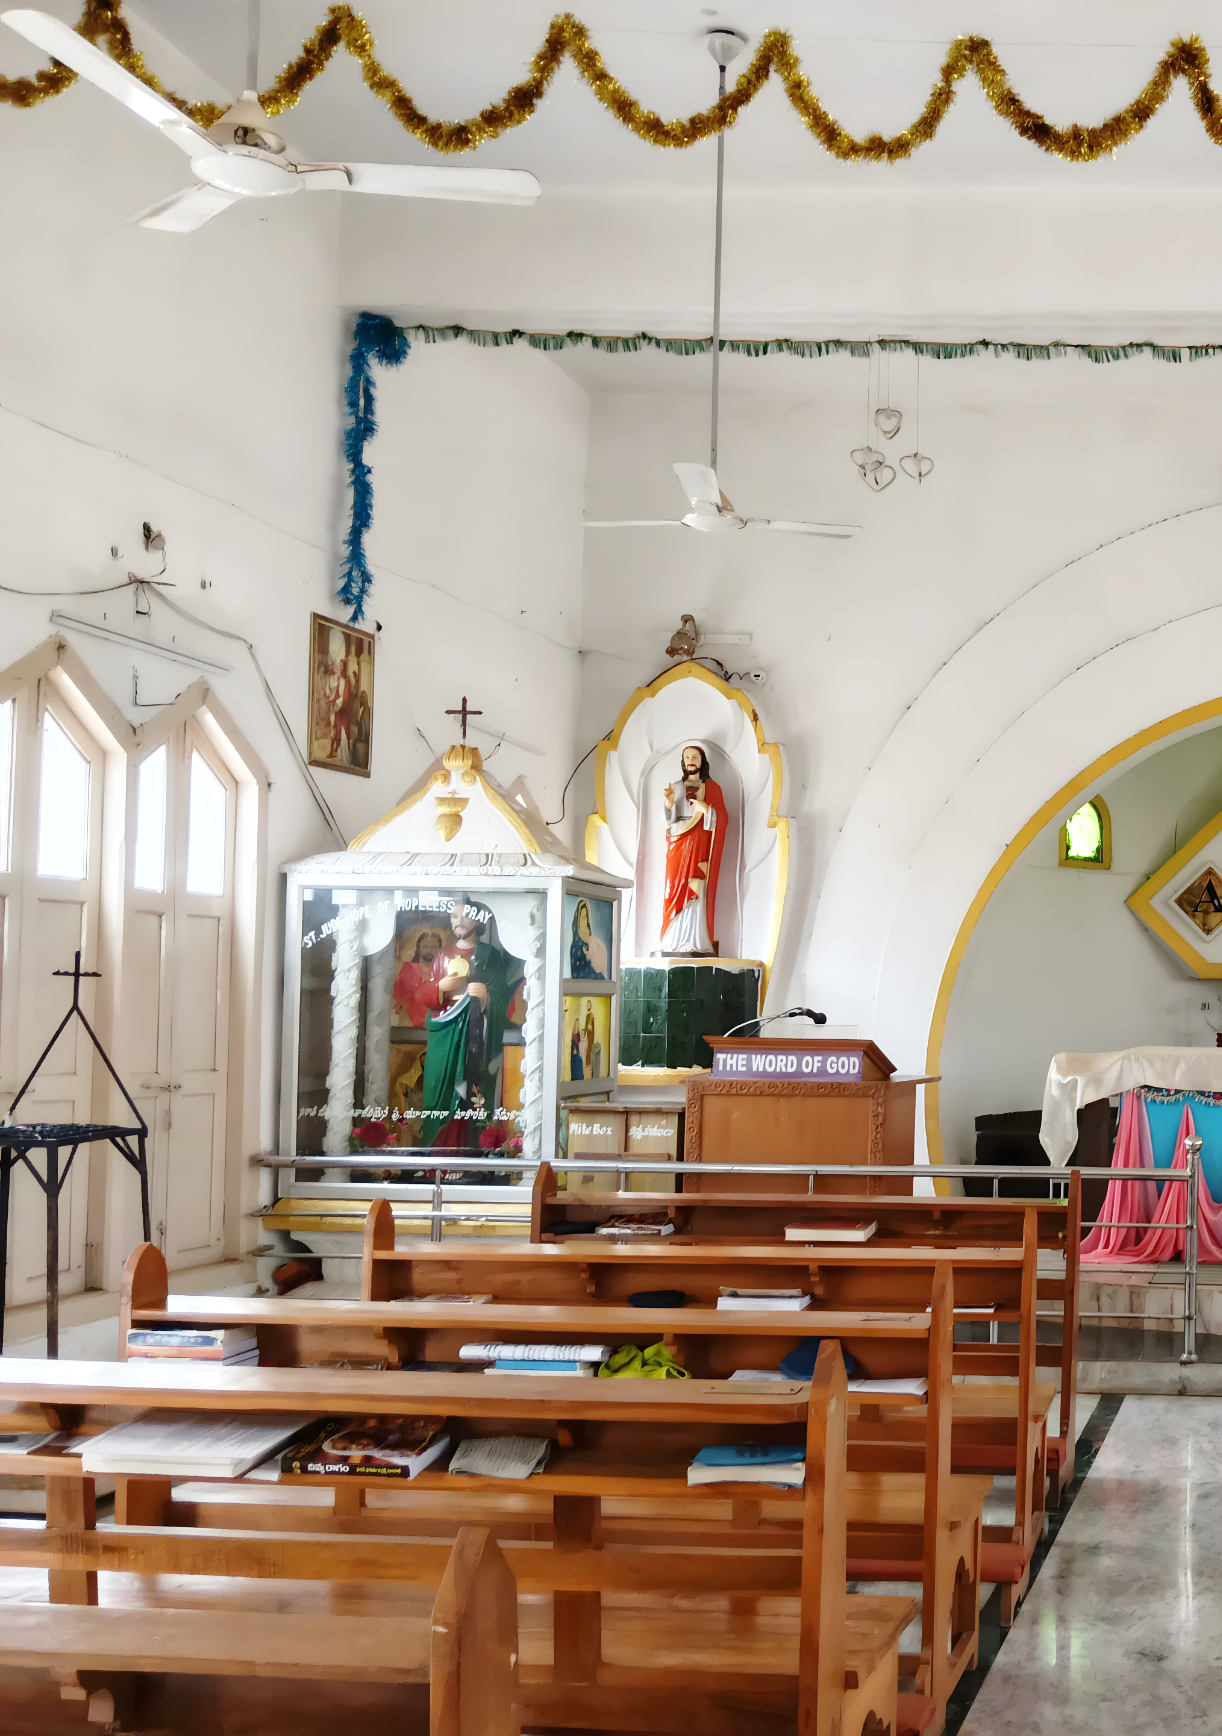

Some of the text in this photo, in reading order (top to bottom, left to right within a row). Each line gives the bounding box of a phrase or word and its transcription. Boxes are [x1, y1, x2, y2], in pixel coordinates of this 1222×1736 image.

[377, 900, 391, 914] OF
[397, 897, 455, 914] HOPELESS
[462, 904, 492, 924] PRAY
[716, 1053, 860, 1074] THE WORD OF GOD
[593, 1123, 613, 1135] Box
[326, 1463, 350, 1473] రాగం
